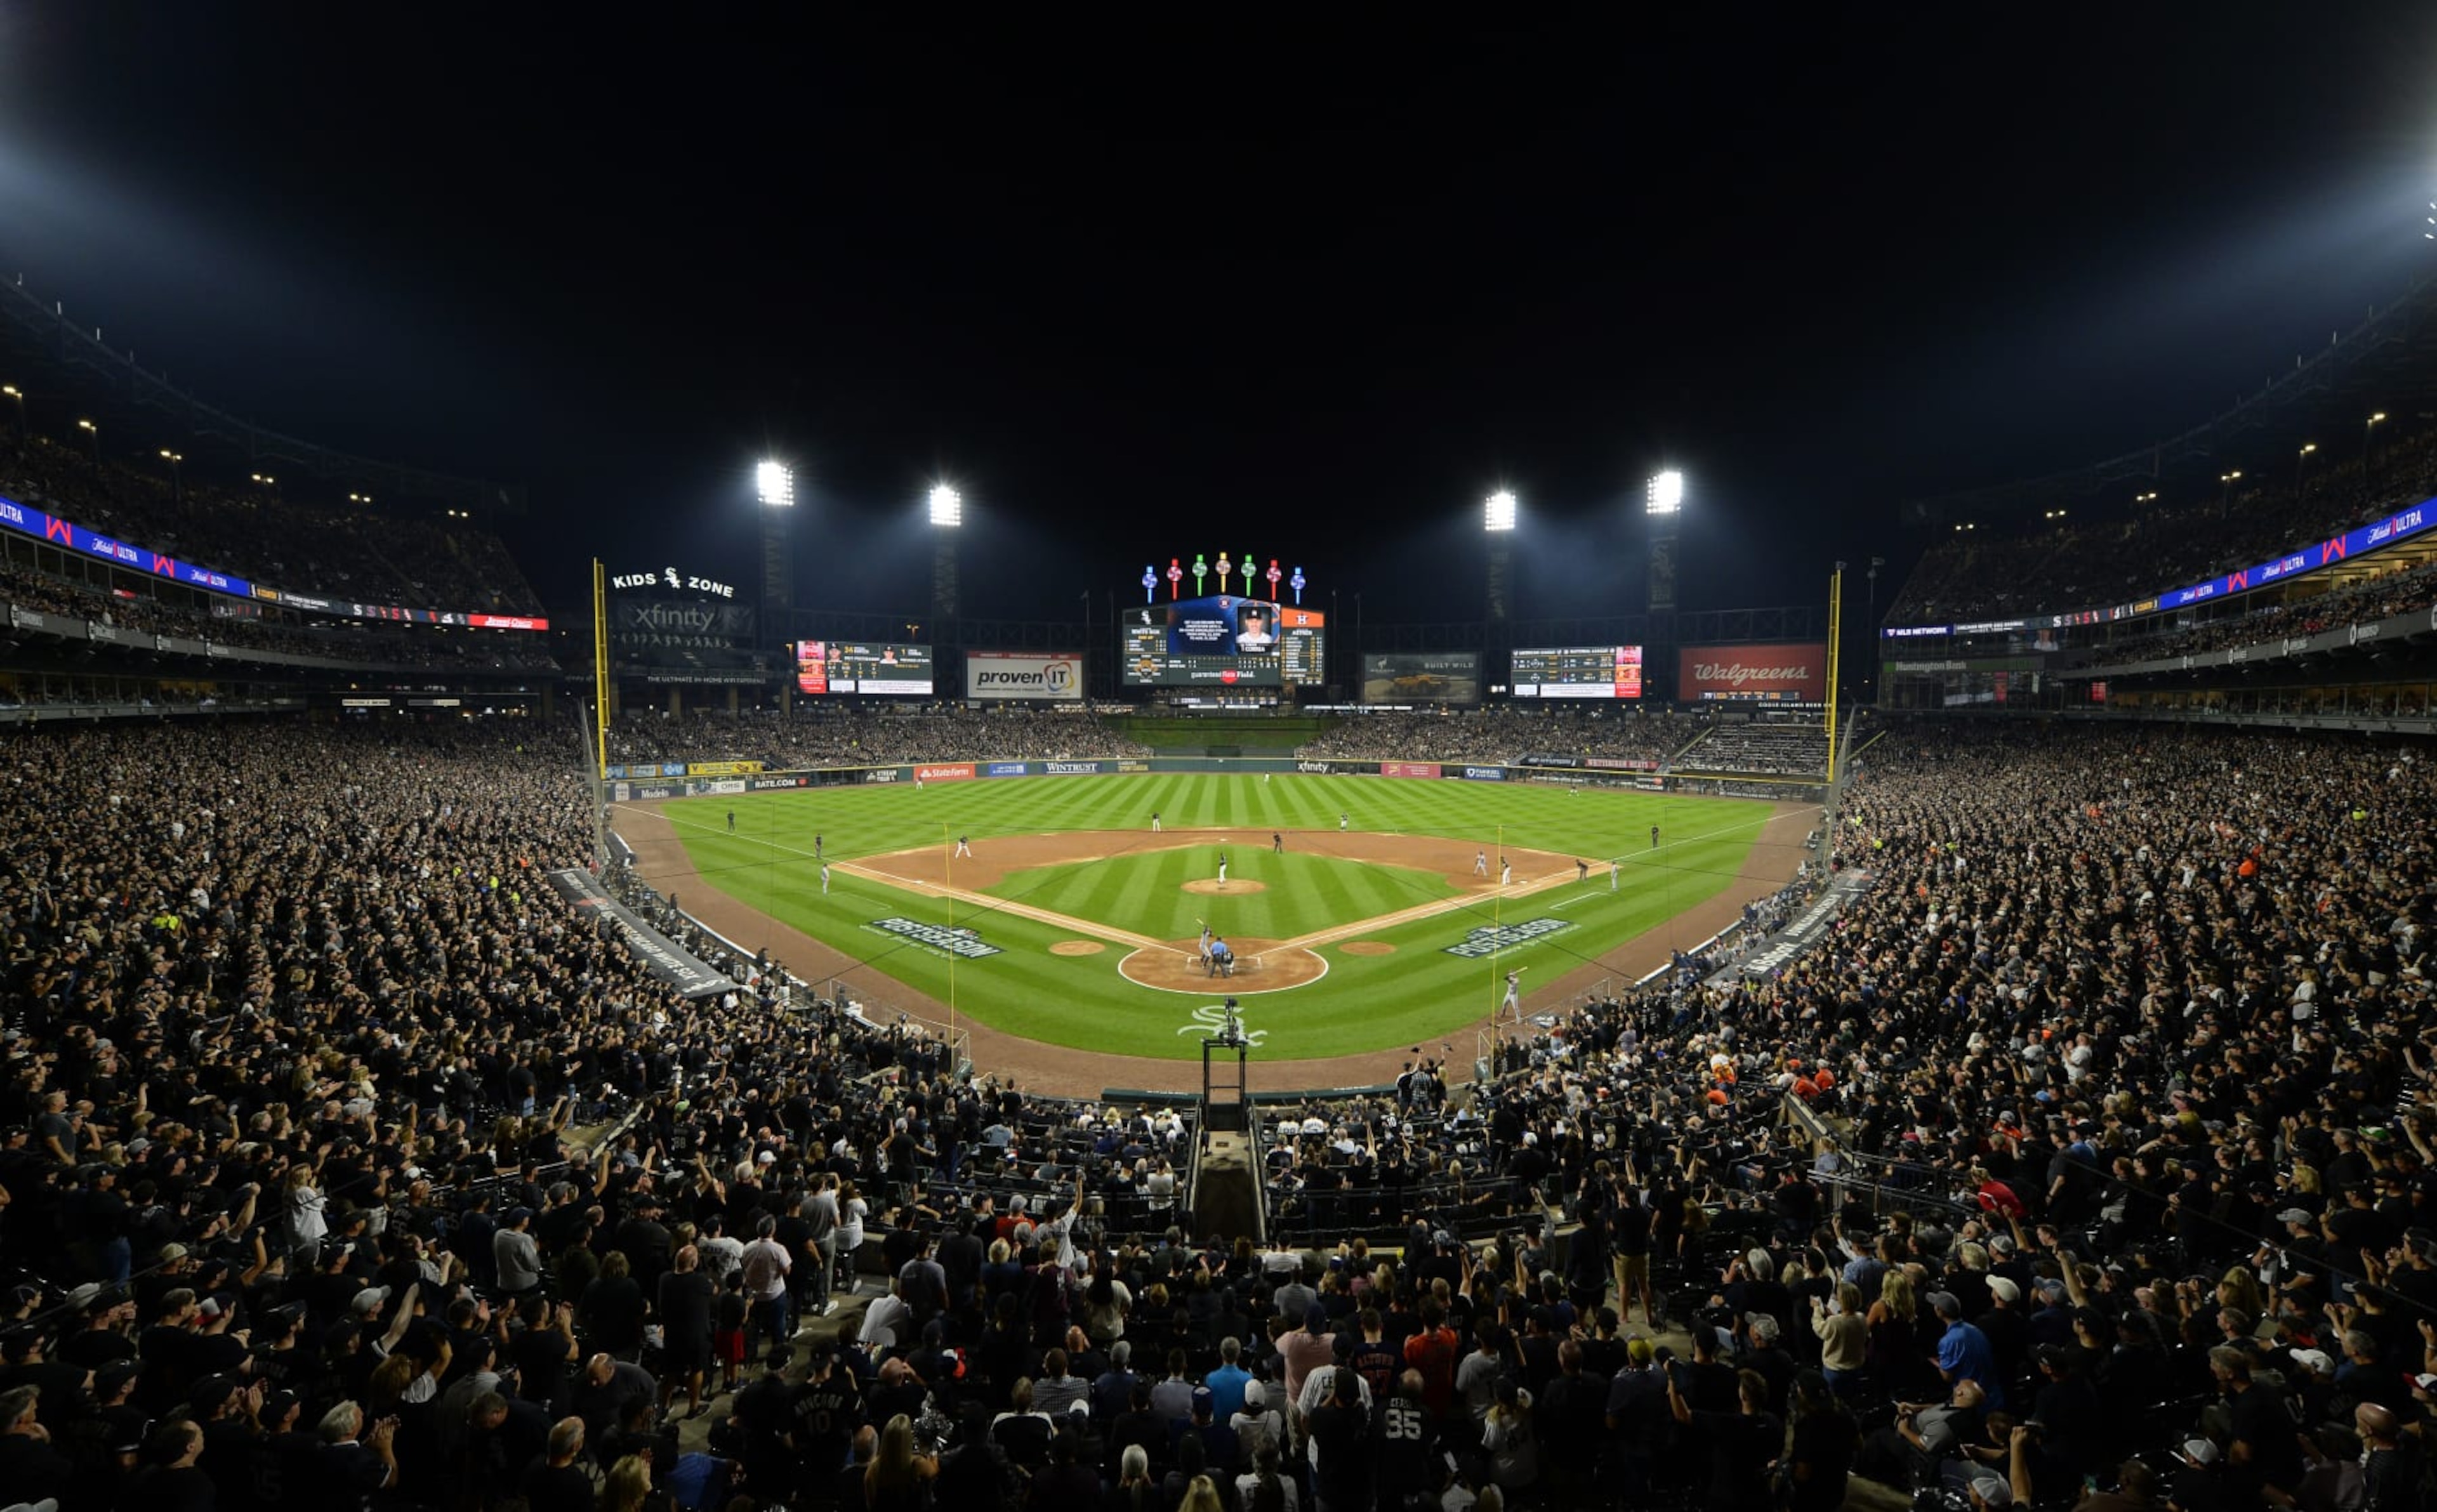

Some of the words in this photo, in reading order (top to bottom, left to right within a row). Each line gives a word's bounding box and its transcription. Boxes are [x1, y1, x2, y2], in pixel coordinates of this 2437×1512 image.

[2396, 509, 2422, 533] ULTRA
[117, 545, 138, 563] ULTRA
[2284, 555, 2305, 571] ULTRA
[612, 573, 657, 589] KIDS
[688, 576, 734, 598] ZONE
[636, 605, 715, 631] xfinity
[977, 671, 1043, 686] proven
[1052, 671, 1067, 683] IT
[1693, 663, 1809, 686] Walgreens
[1047, 763, 1098, 772] WINTRUST
[1297, 761, 1329, 774] xfinity
[755, 779, 796, 790] RATE.COM
